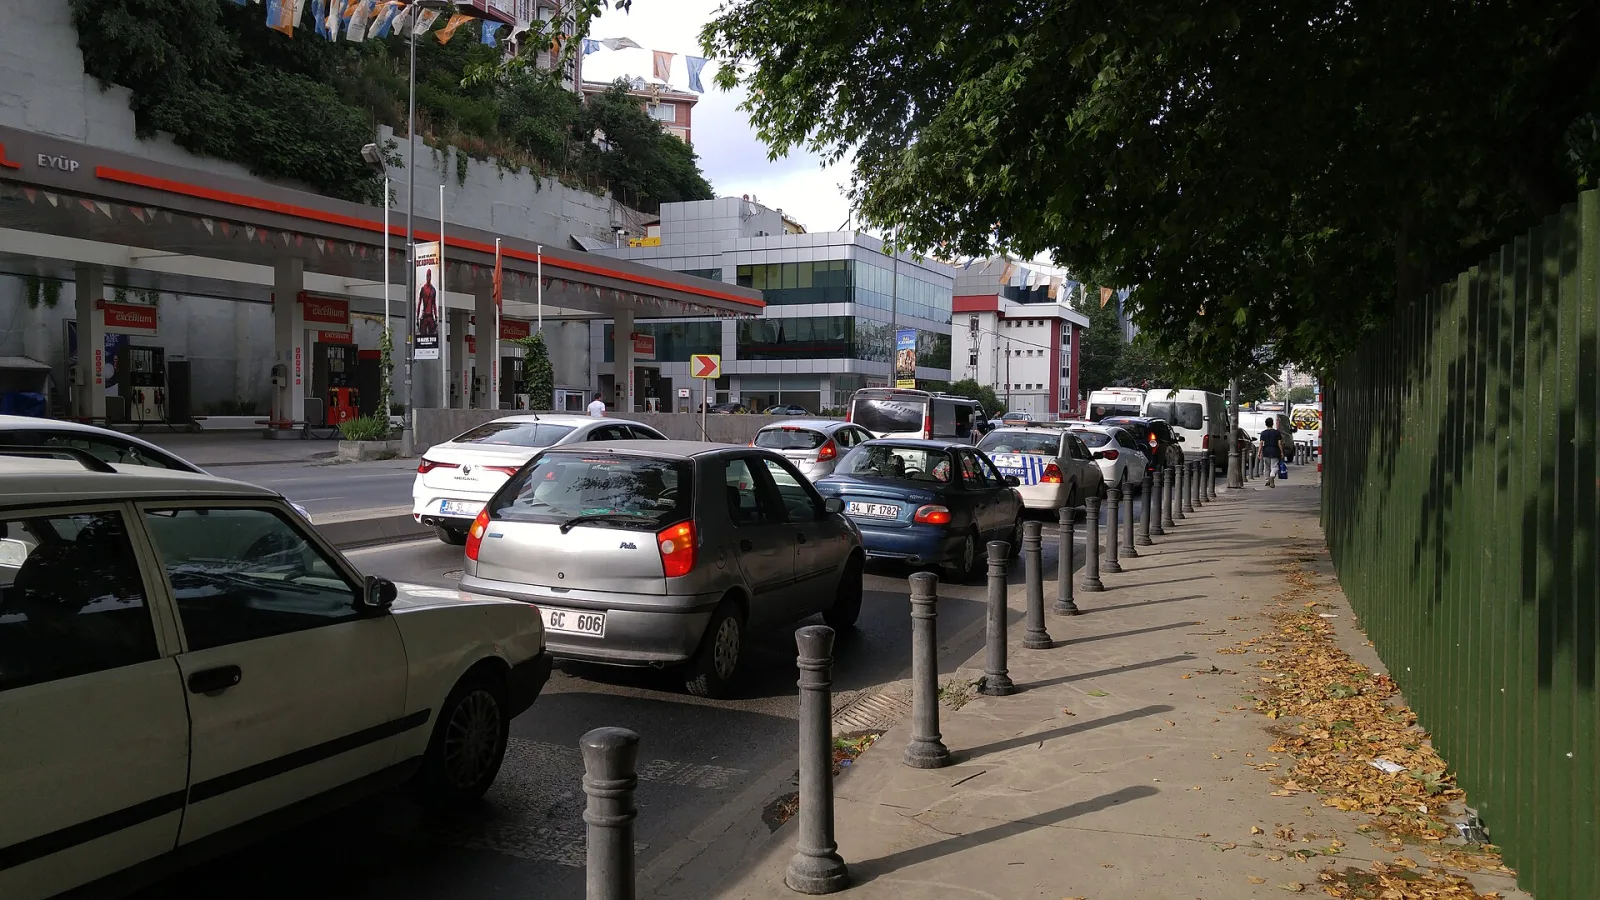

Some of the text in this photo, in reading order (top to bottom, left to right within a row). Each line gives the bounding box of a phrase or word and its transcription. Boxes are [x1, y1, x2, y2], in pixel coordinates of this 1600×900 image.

[38, 153, 79, 172] EYÜP
[116, 312, 152, 323] excellium
[313, 306, 345, 317] excellium
[851, 503, 897, 516] 34 VF 1782
[550, 611, 601, 632] GC 606
